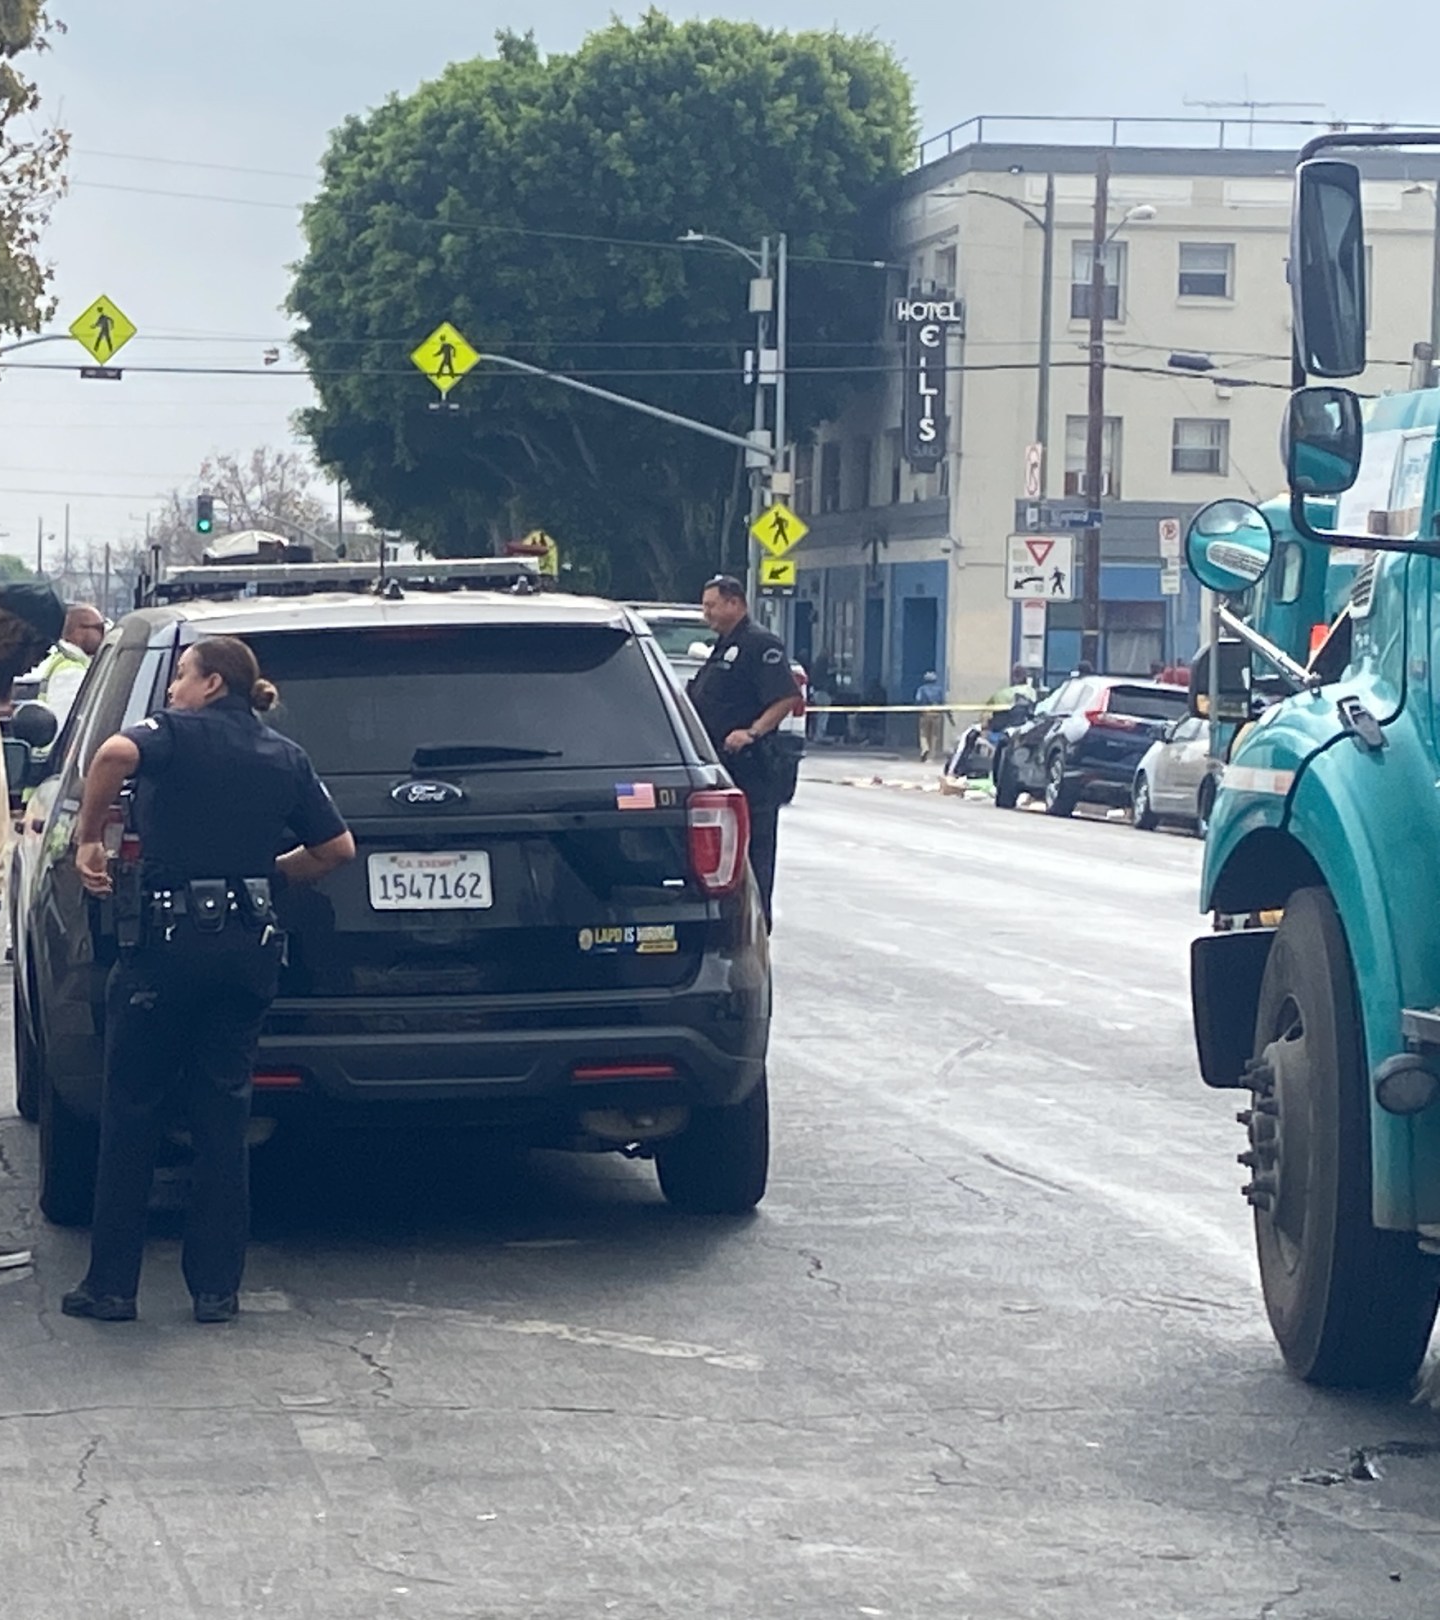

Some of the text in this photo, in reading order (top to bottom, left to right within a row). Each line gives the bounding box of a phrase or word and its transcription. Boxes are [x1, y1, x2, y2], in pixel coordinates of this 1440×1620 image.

[897, 301, 961, 322] HOTEL
[408, 784, 446, 802] Ford
[397, 860, 414, 869] CA
[379, 872, 482, 901] 1547162
[594, 927, 623, 944] LAPD
